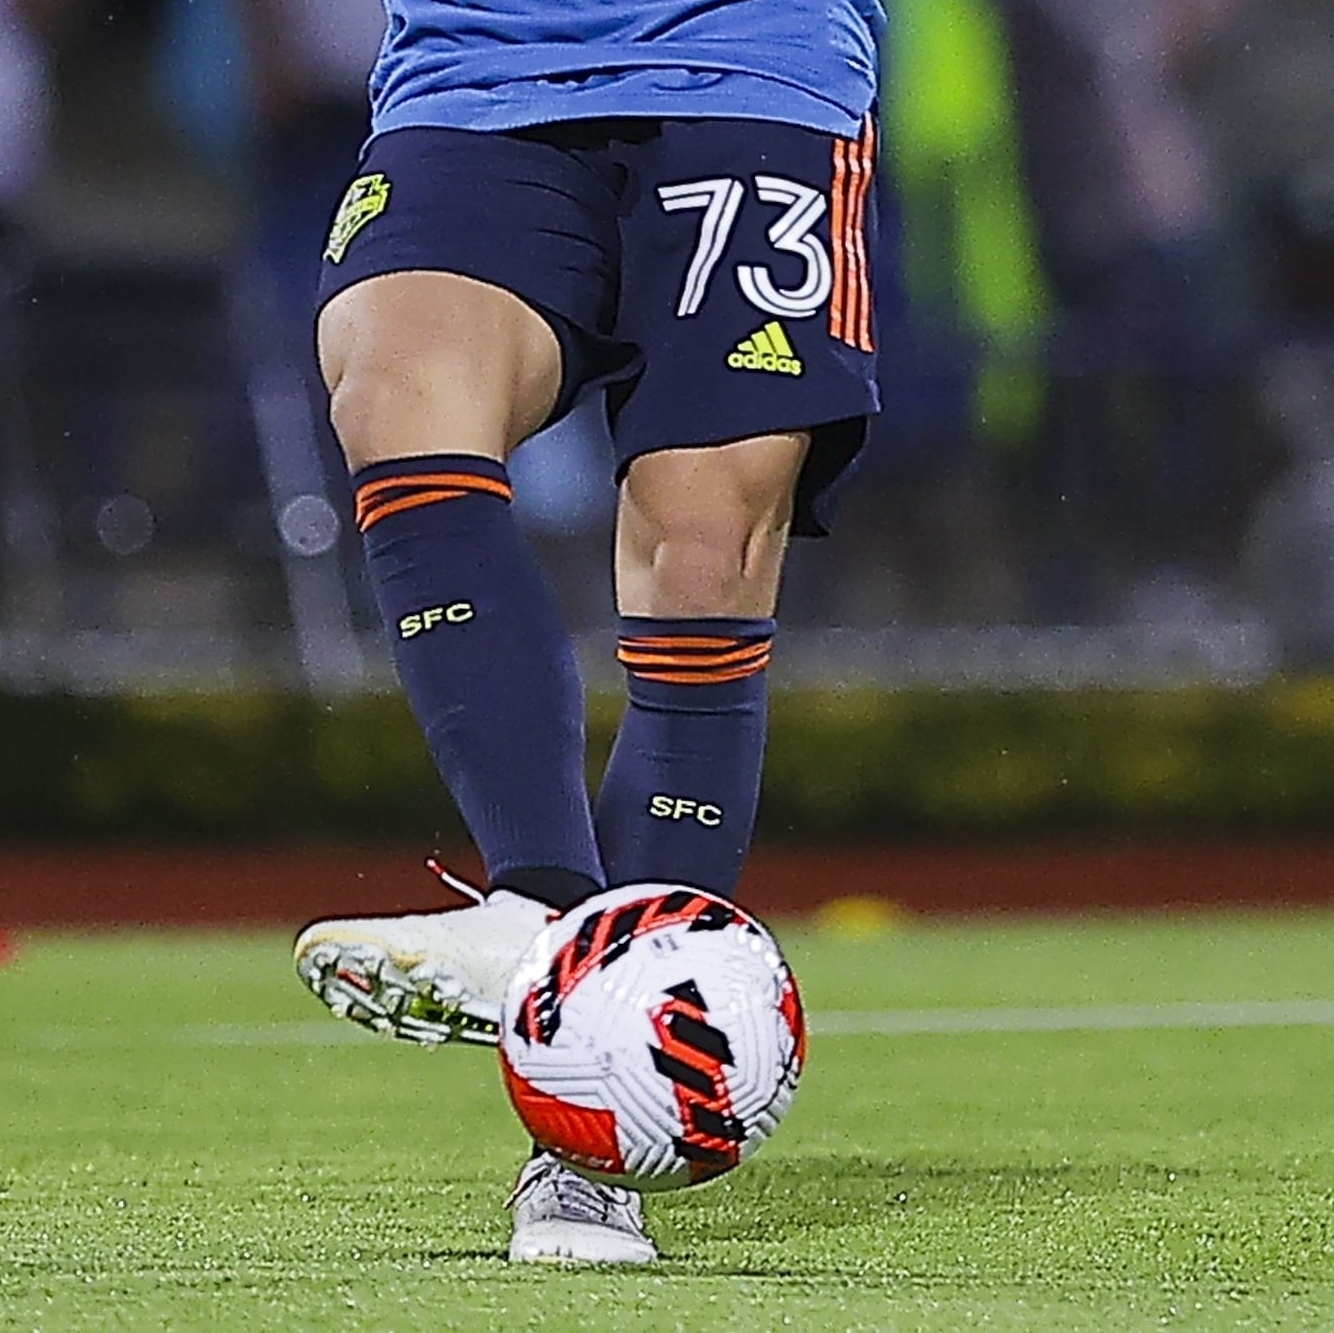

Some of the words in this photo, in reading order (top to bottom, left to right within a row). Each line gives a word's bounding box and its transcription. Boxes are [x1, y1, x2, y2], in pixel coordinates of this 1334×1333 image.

[657, 175, 832, 318] 73
[727, 352, 802, 376] adidas
[399, 603, 474, 638] SFC
[650, 795, 723, 826] SFC
